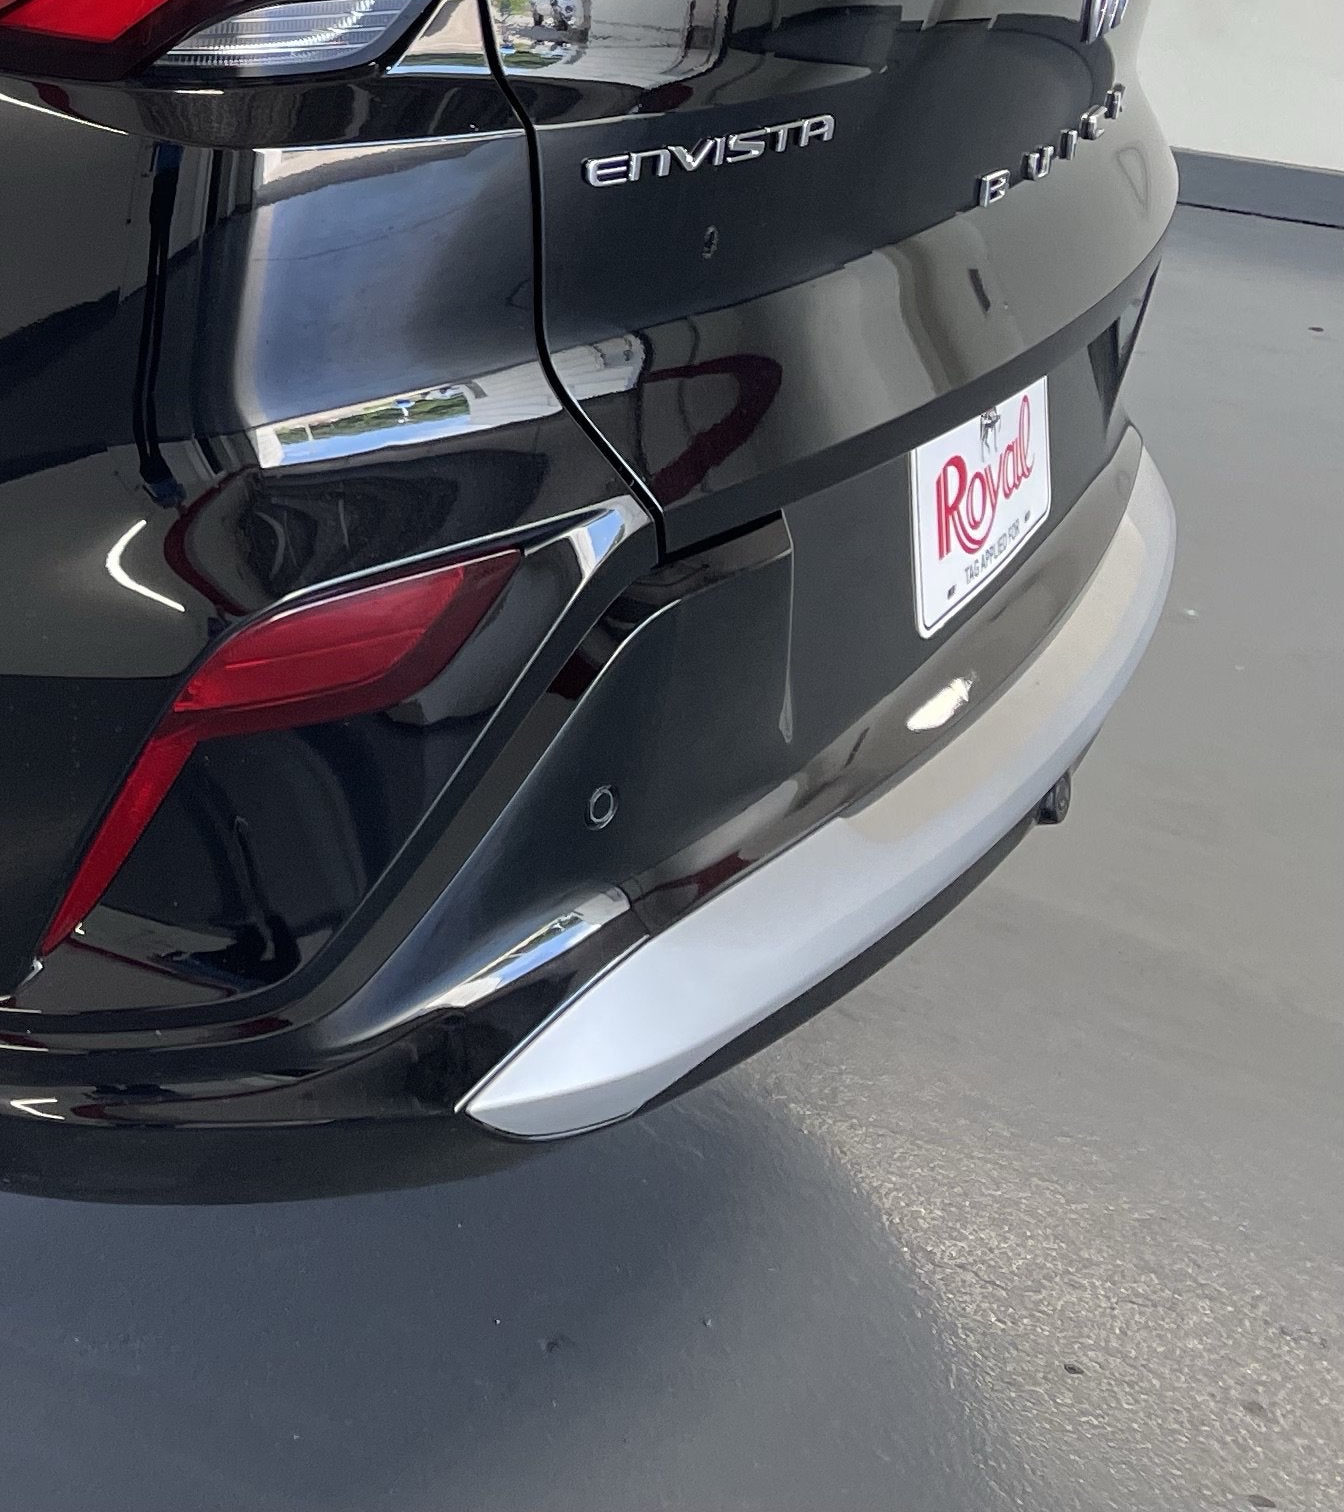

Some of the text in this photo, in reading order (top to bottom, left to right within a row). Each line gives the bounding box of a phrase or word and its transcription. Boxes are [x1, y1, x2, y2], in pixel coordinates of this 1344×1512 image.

[581, 114, 837, 188] ENVISTA
[935, 394, 1035, 561] Royal
[964, 518, 1020, 585] TAG APPLIED FOR
